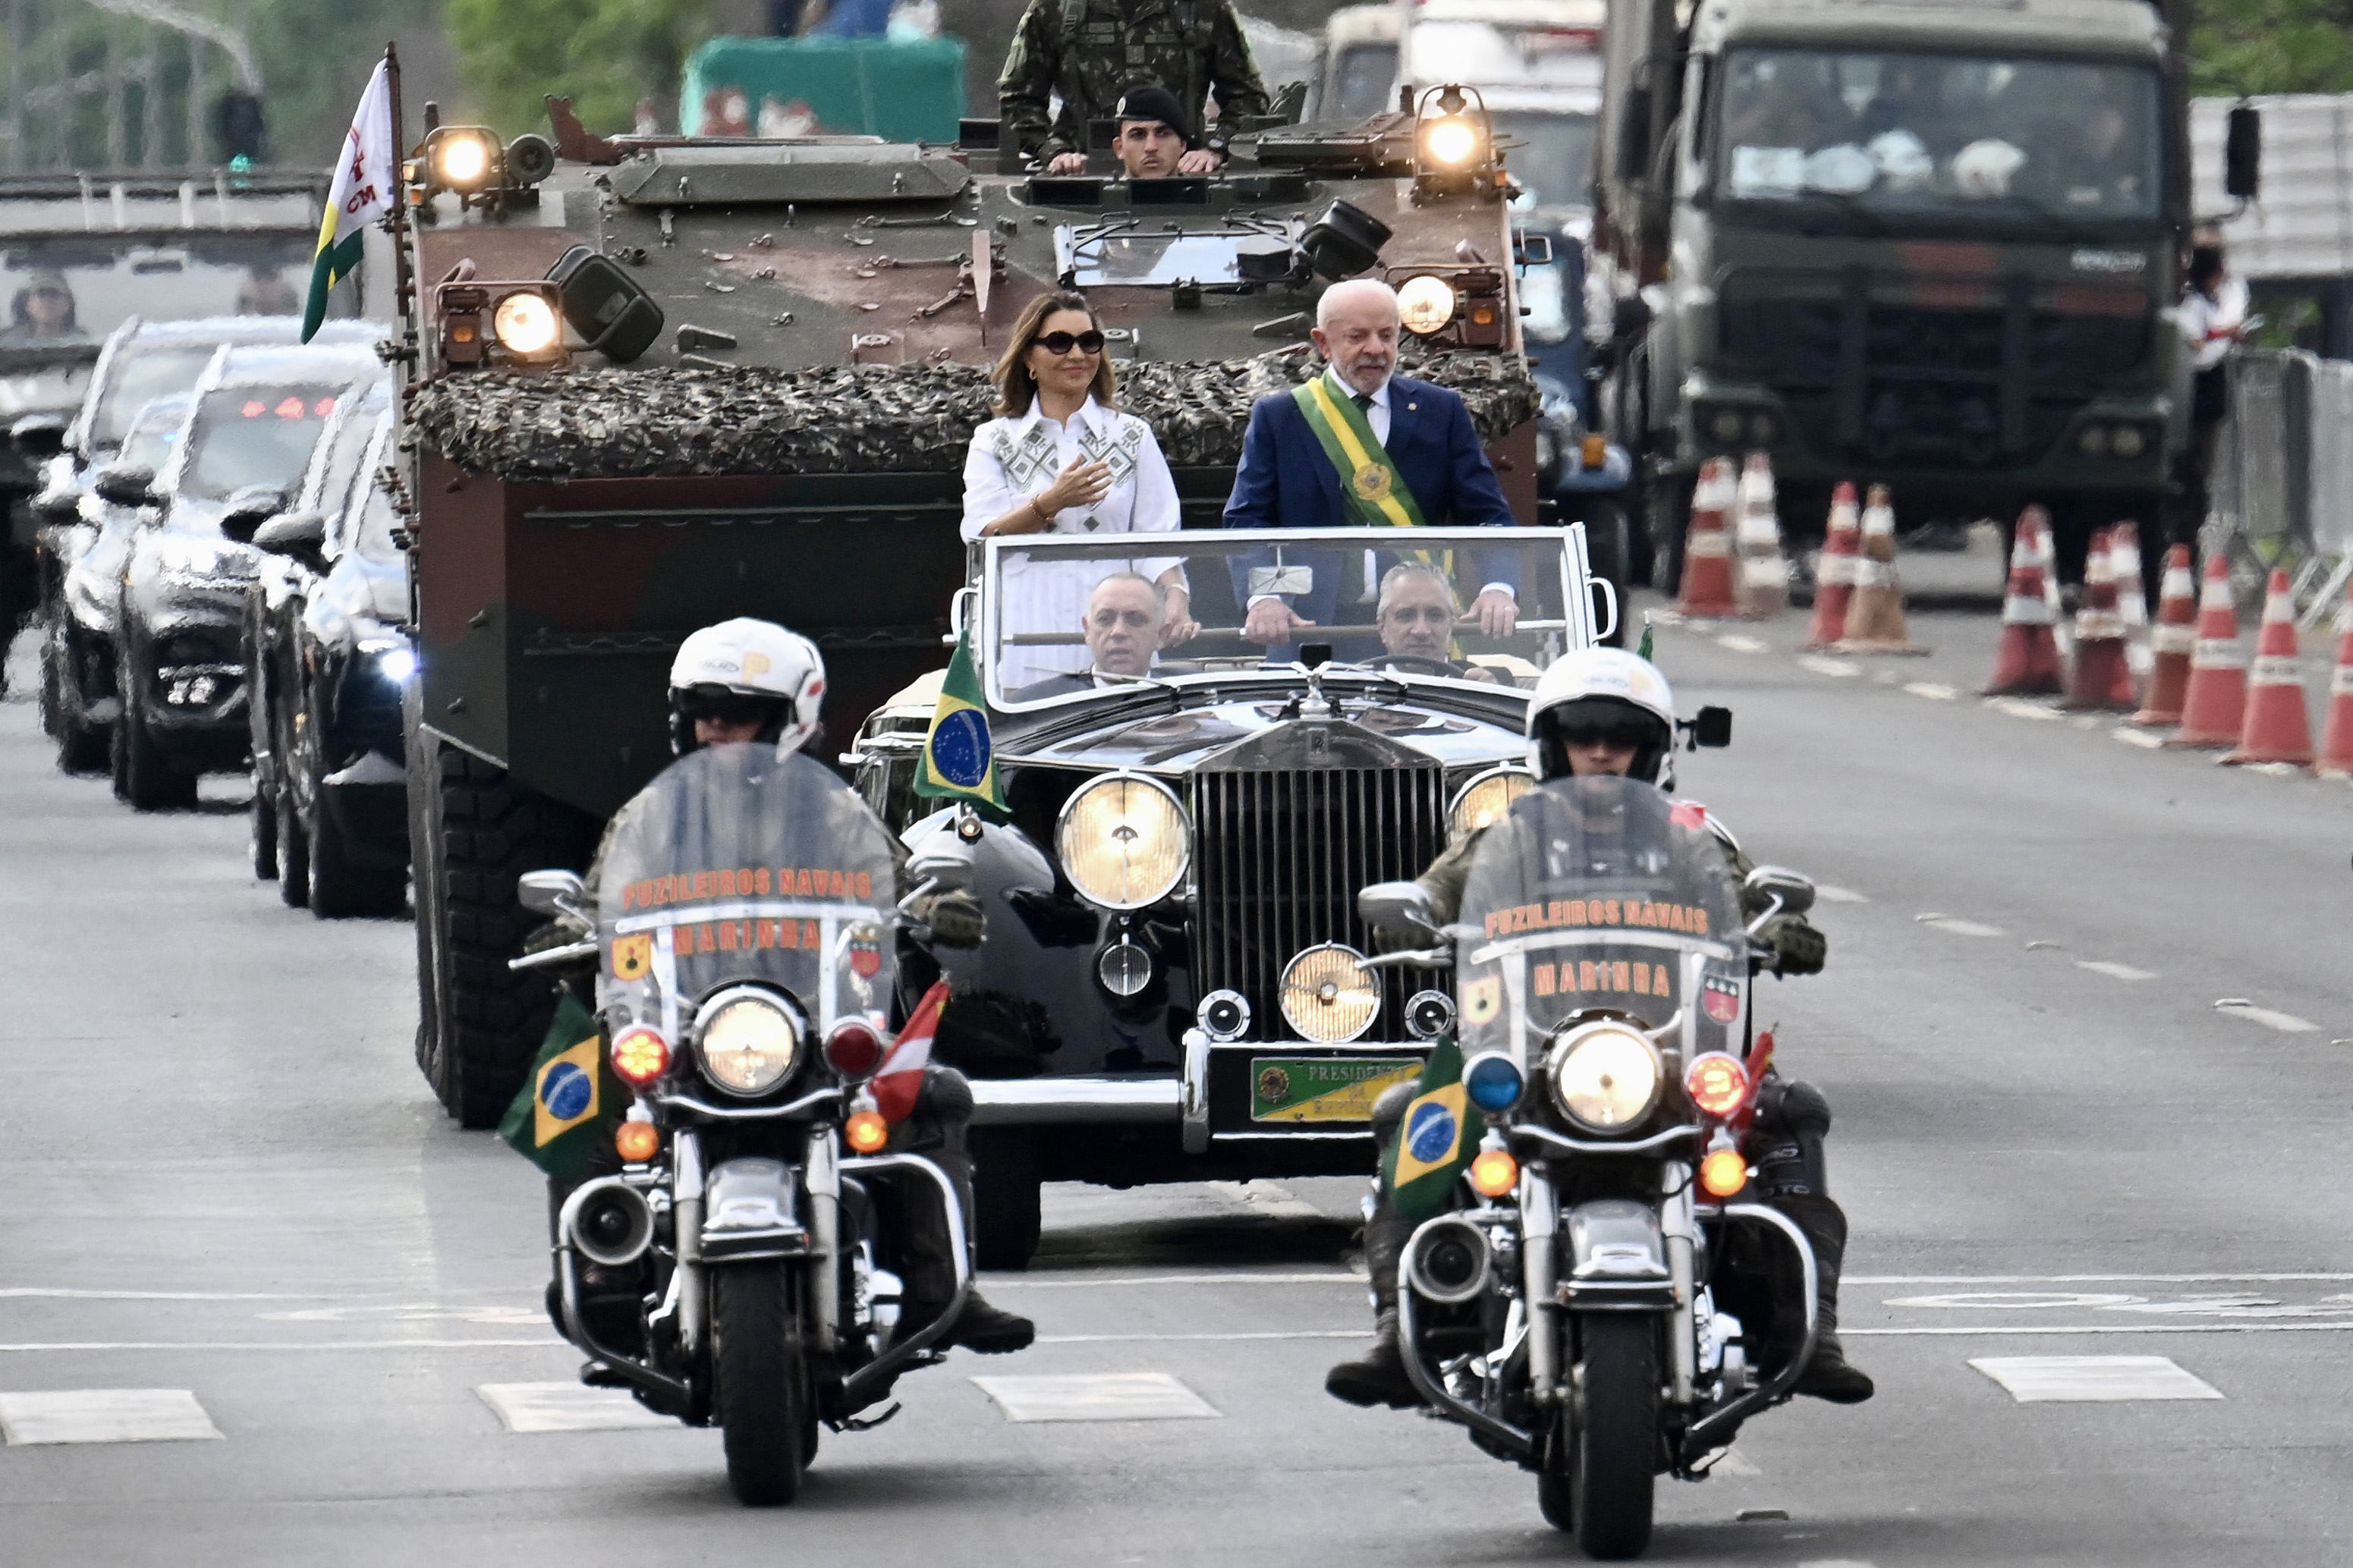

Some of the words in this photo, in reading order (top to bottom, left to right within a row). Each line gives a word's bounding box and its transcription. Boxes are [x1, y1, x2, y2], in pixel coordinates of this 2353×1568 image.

[347, 184, 376, 214] CM
[623, 868, 771, 910] FUZILEIROS
[779, 868, 872, 900] NAVAIS
[672, 918, 821, 956] MARINHA
[1485, 899, 1621, 939] FUZILEIROS
[1623, 900, 1708, 935] NAVAIS
[1534, 959, 1670, 997] MARINHA
